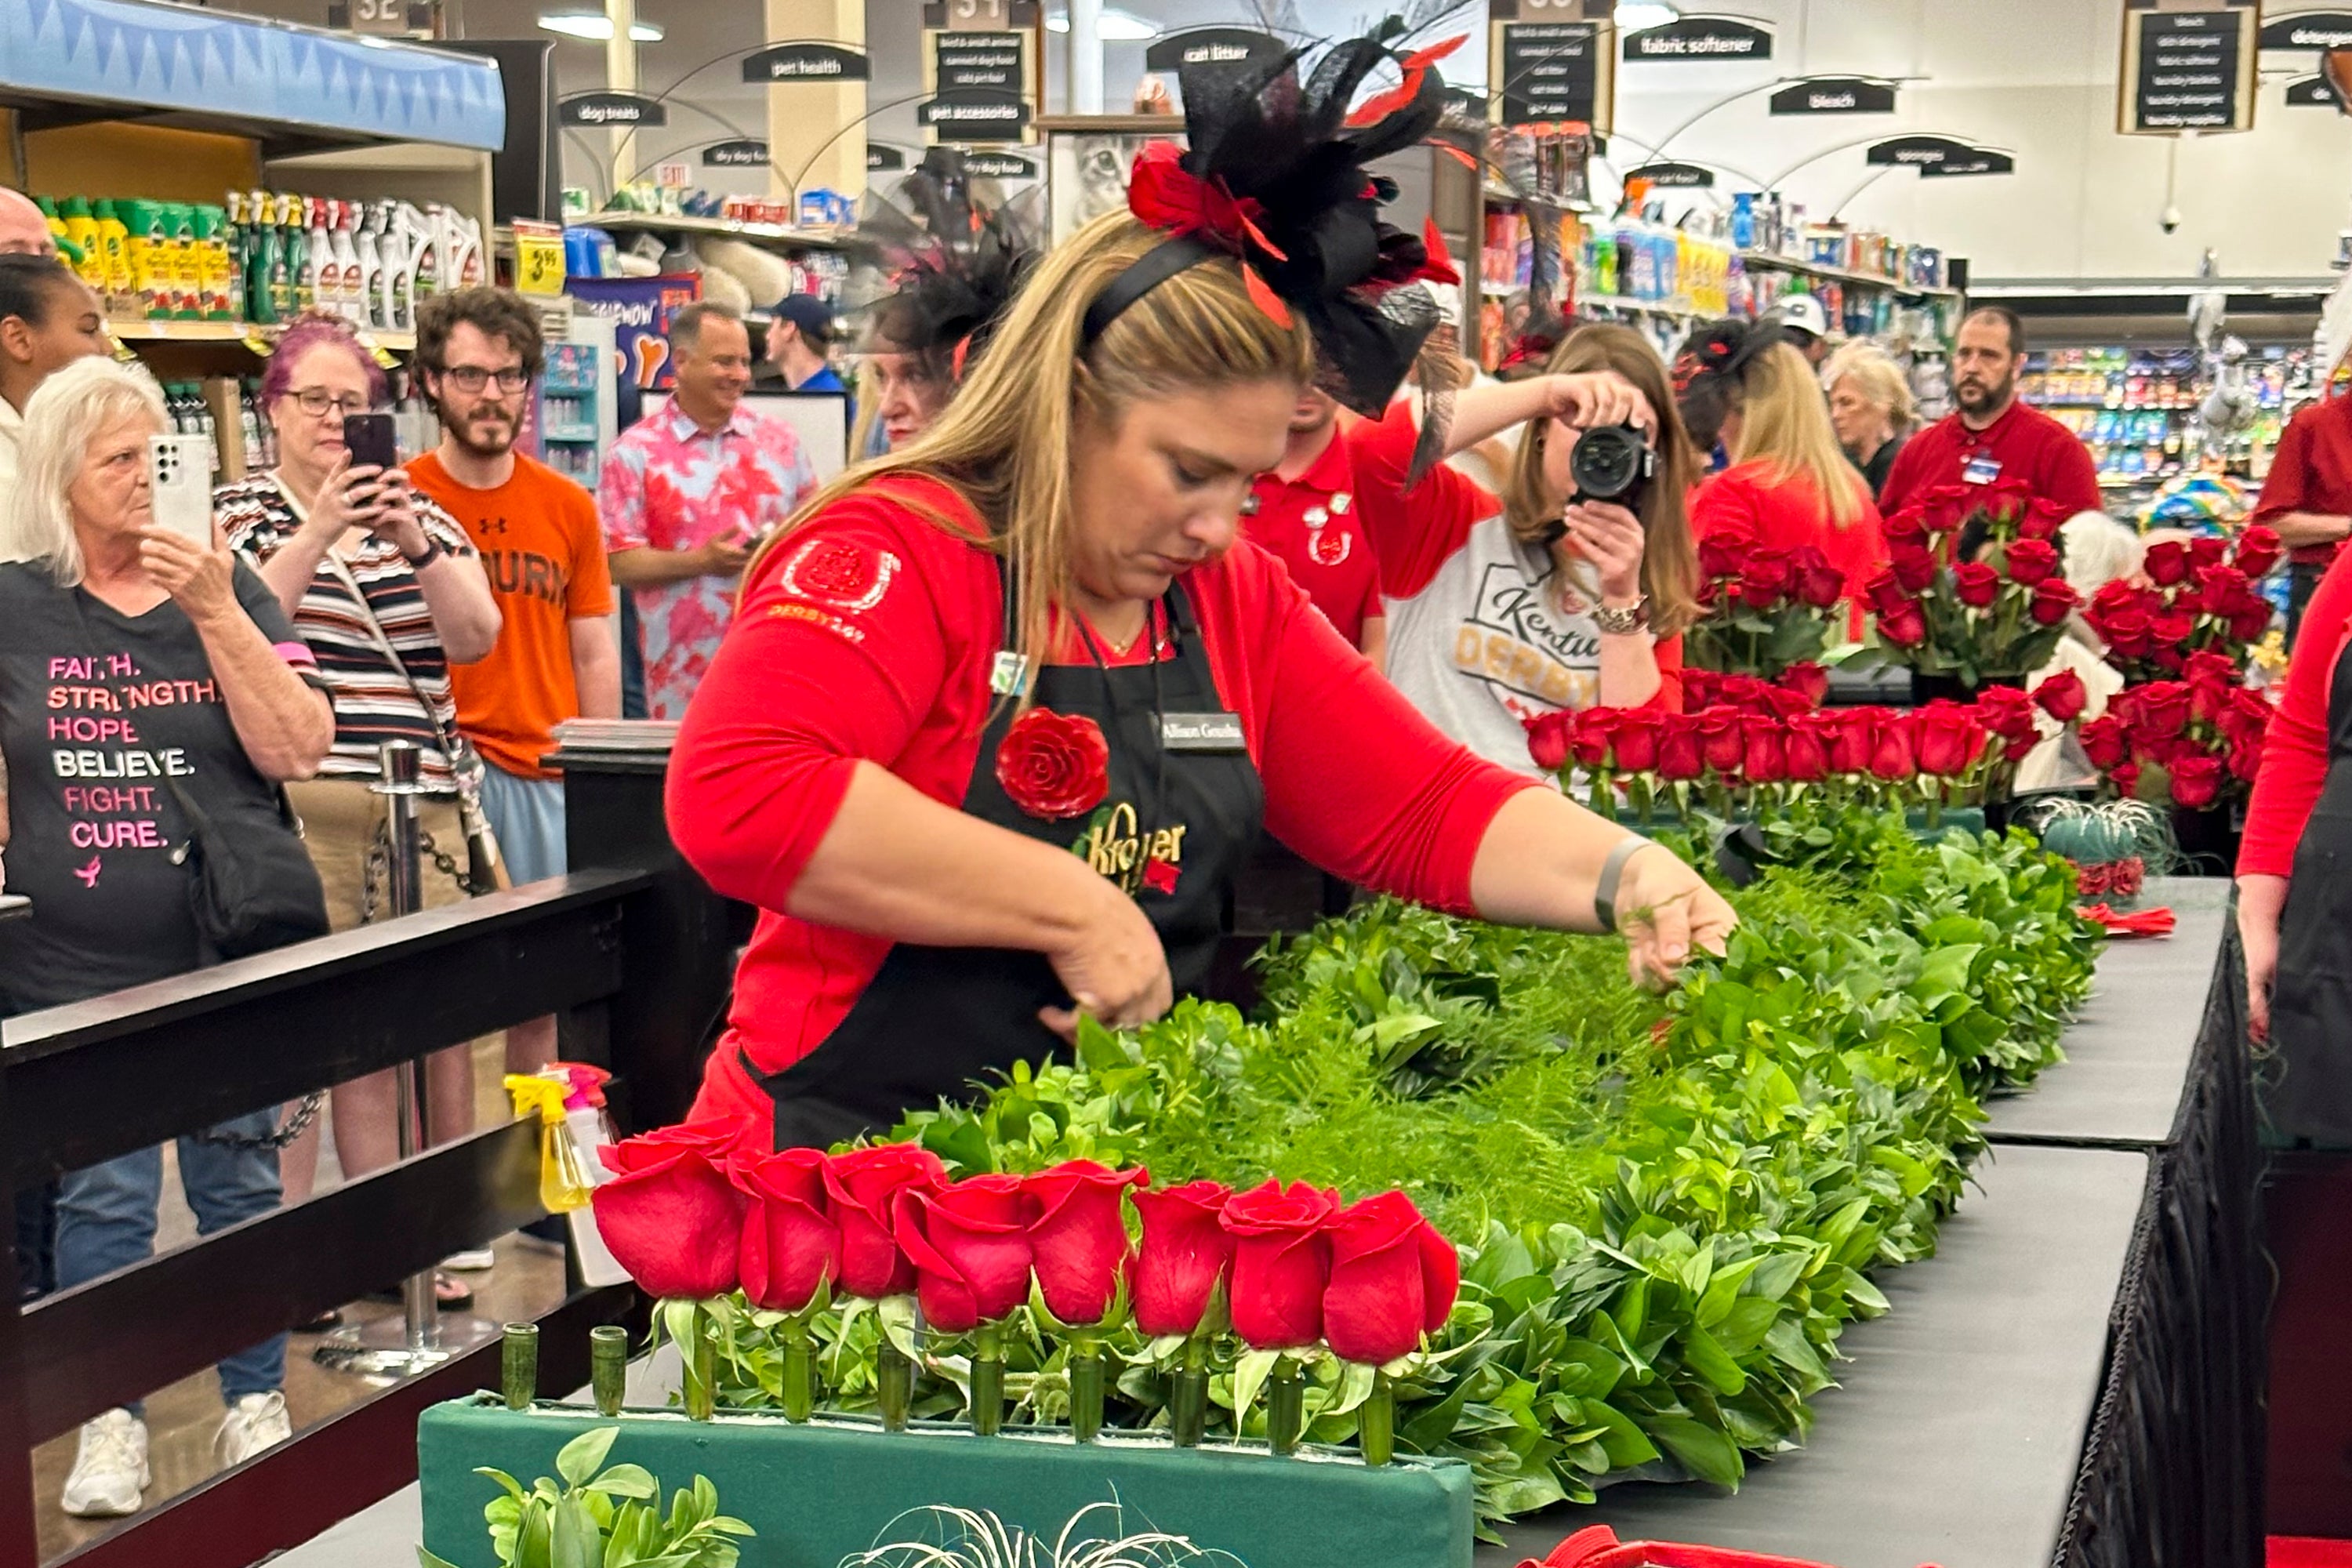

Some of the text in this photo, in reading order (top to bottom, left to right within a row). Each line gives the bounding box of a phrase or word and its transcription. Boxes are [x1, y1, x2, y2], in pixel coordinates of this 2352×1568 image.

[1641, 34, 1755, 54] fabric softener
[771, 56, 842, 78] pet health
[578, 104, 605, 123] dog
[928, 105, 952, 122] pet
[480, 550, 567, 610] URN
[53, 747, 196, 779] BELIEVE.
[64, 786, 163, 812] FIGHT.
[70, 819, 169, 848] CURE.
